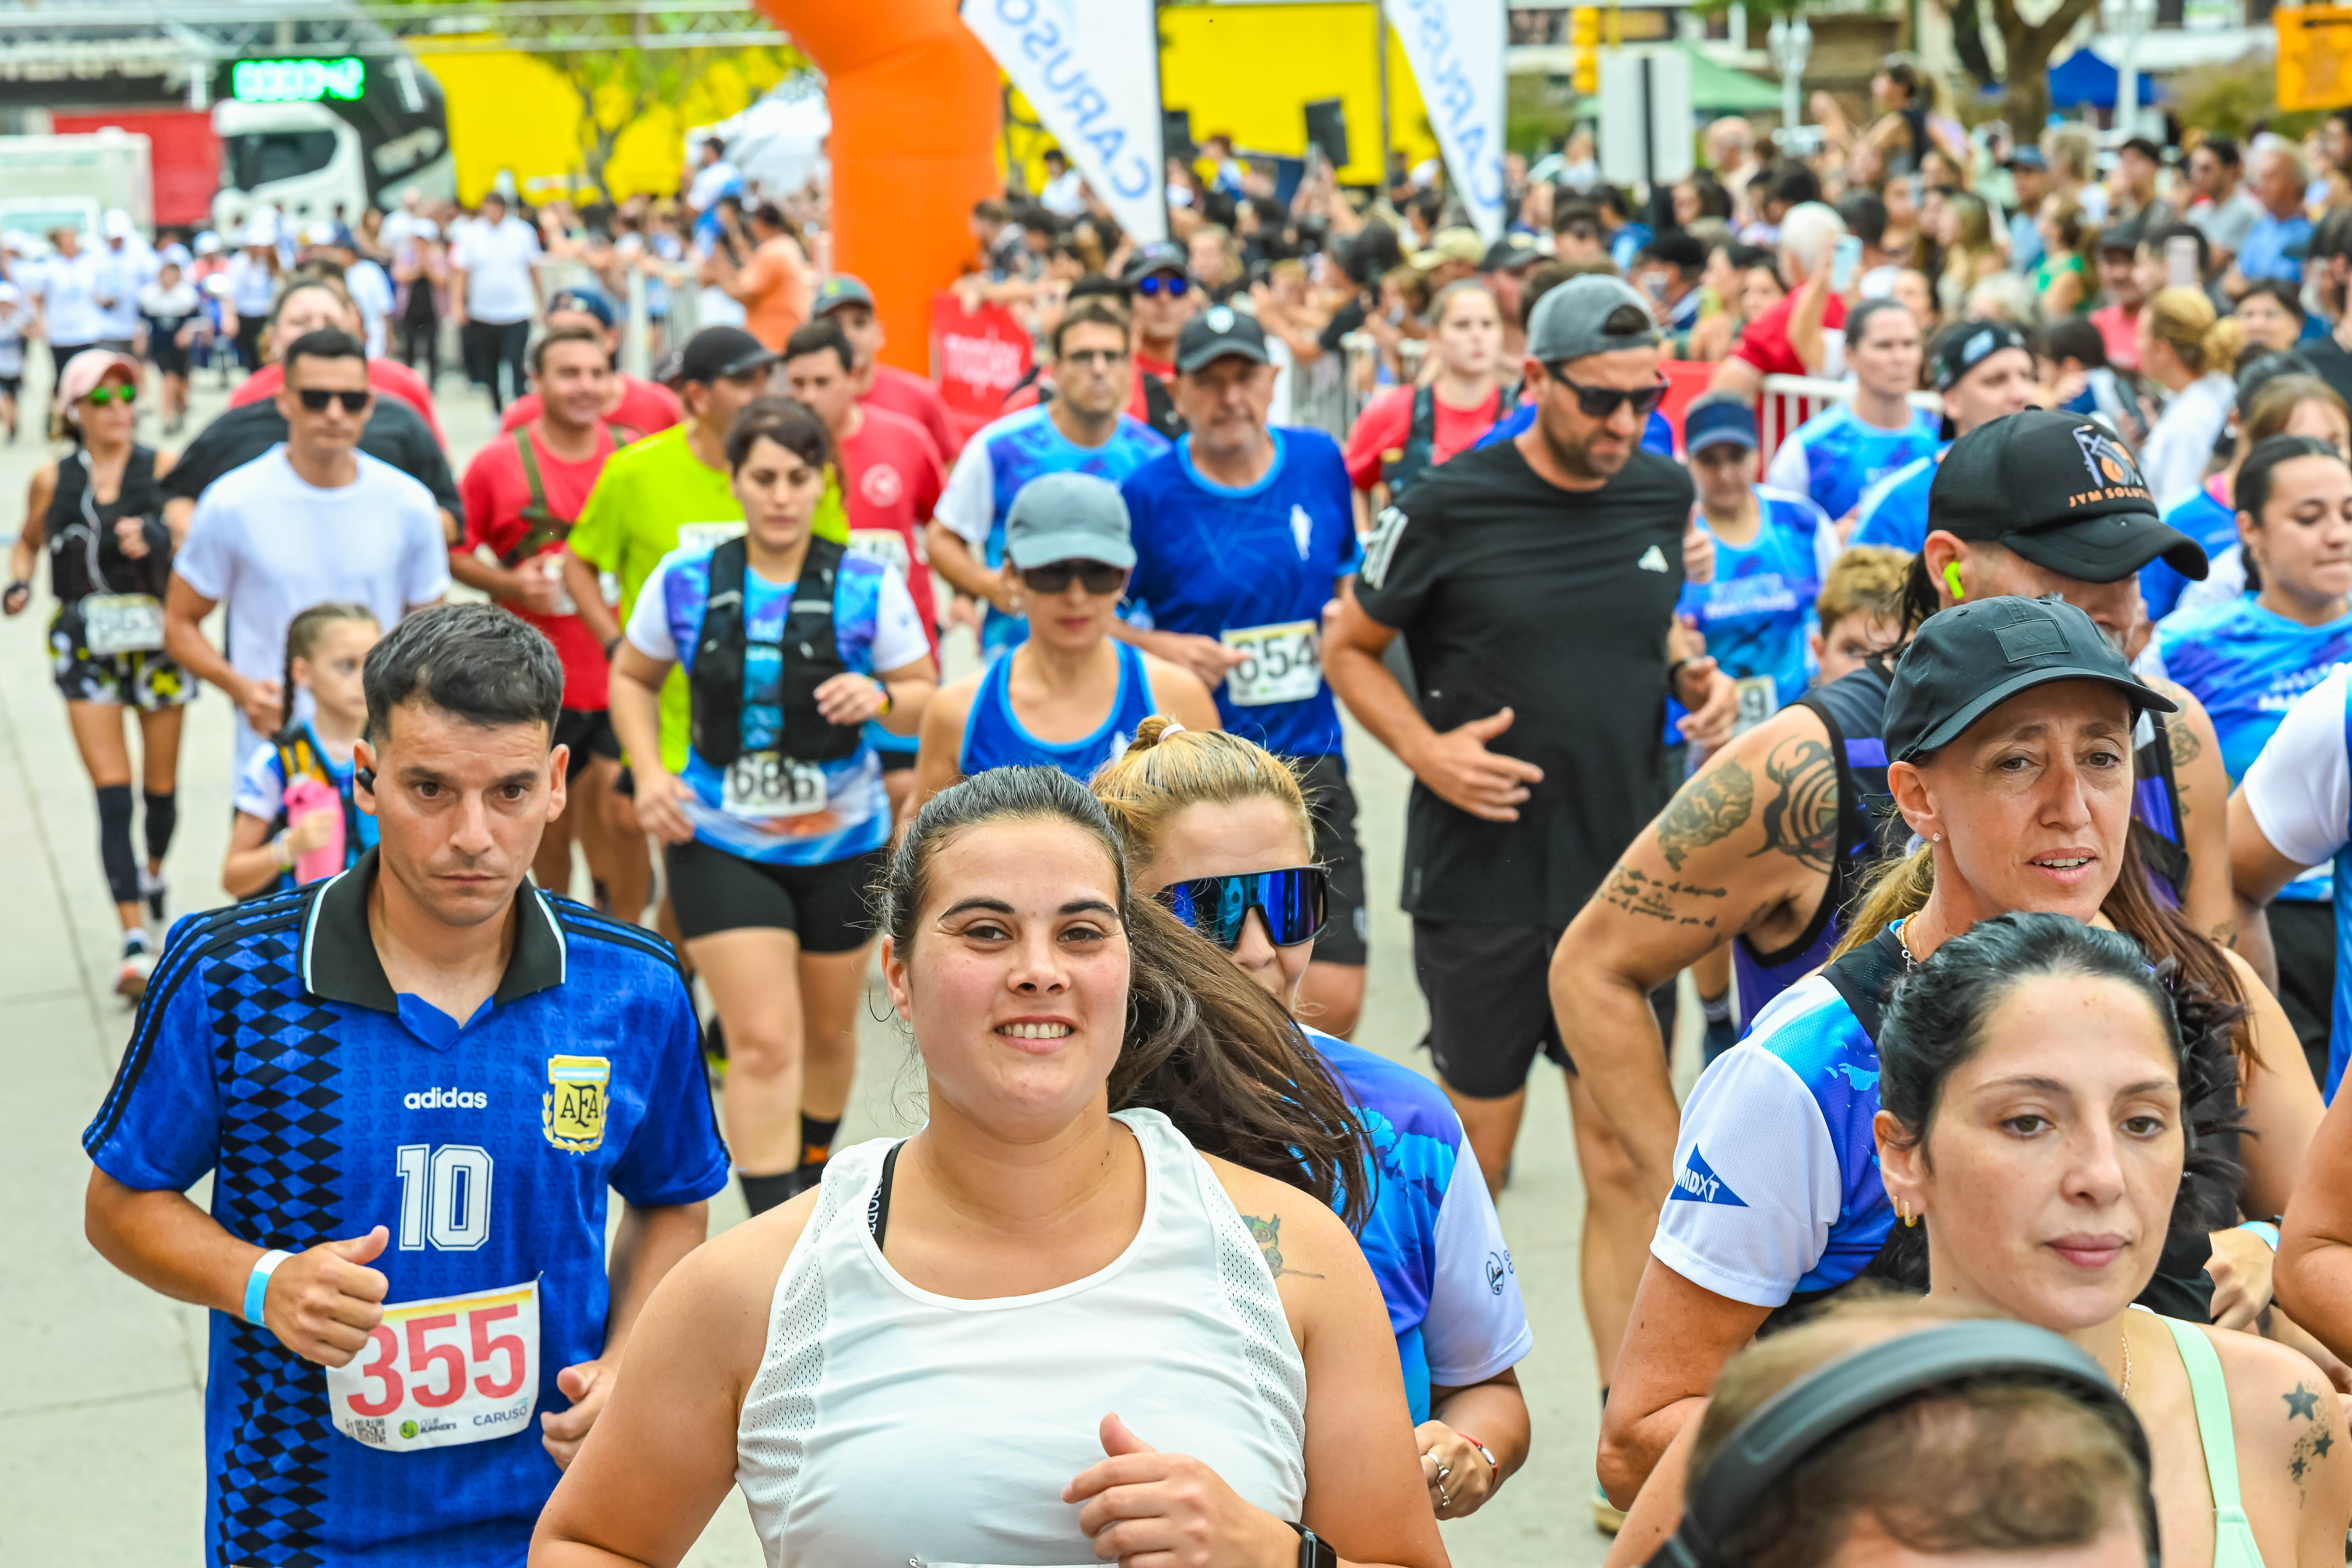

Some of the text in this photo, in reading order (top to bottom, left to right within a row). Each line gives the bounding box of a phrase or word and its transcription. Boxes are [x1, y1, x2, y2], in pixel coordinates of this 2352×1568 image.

[2069, 490, 2103, 508] JYM
[404, 1087, 488, 1110] adidas
[560, 1083, 598, 1128] AFA
[396, 1143, 494, 1251] 10
[1677, 1167, 1720, 1203] MDXT
[346, 1304, 526, 1417] 355
[472, 1405, 528, 1426] CARUSO
